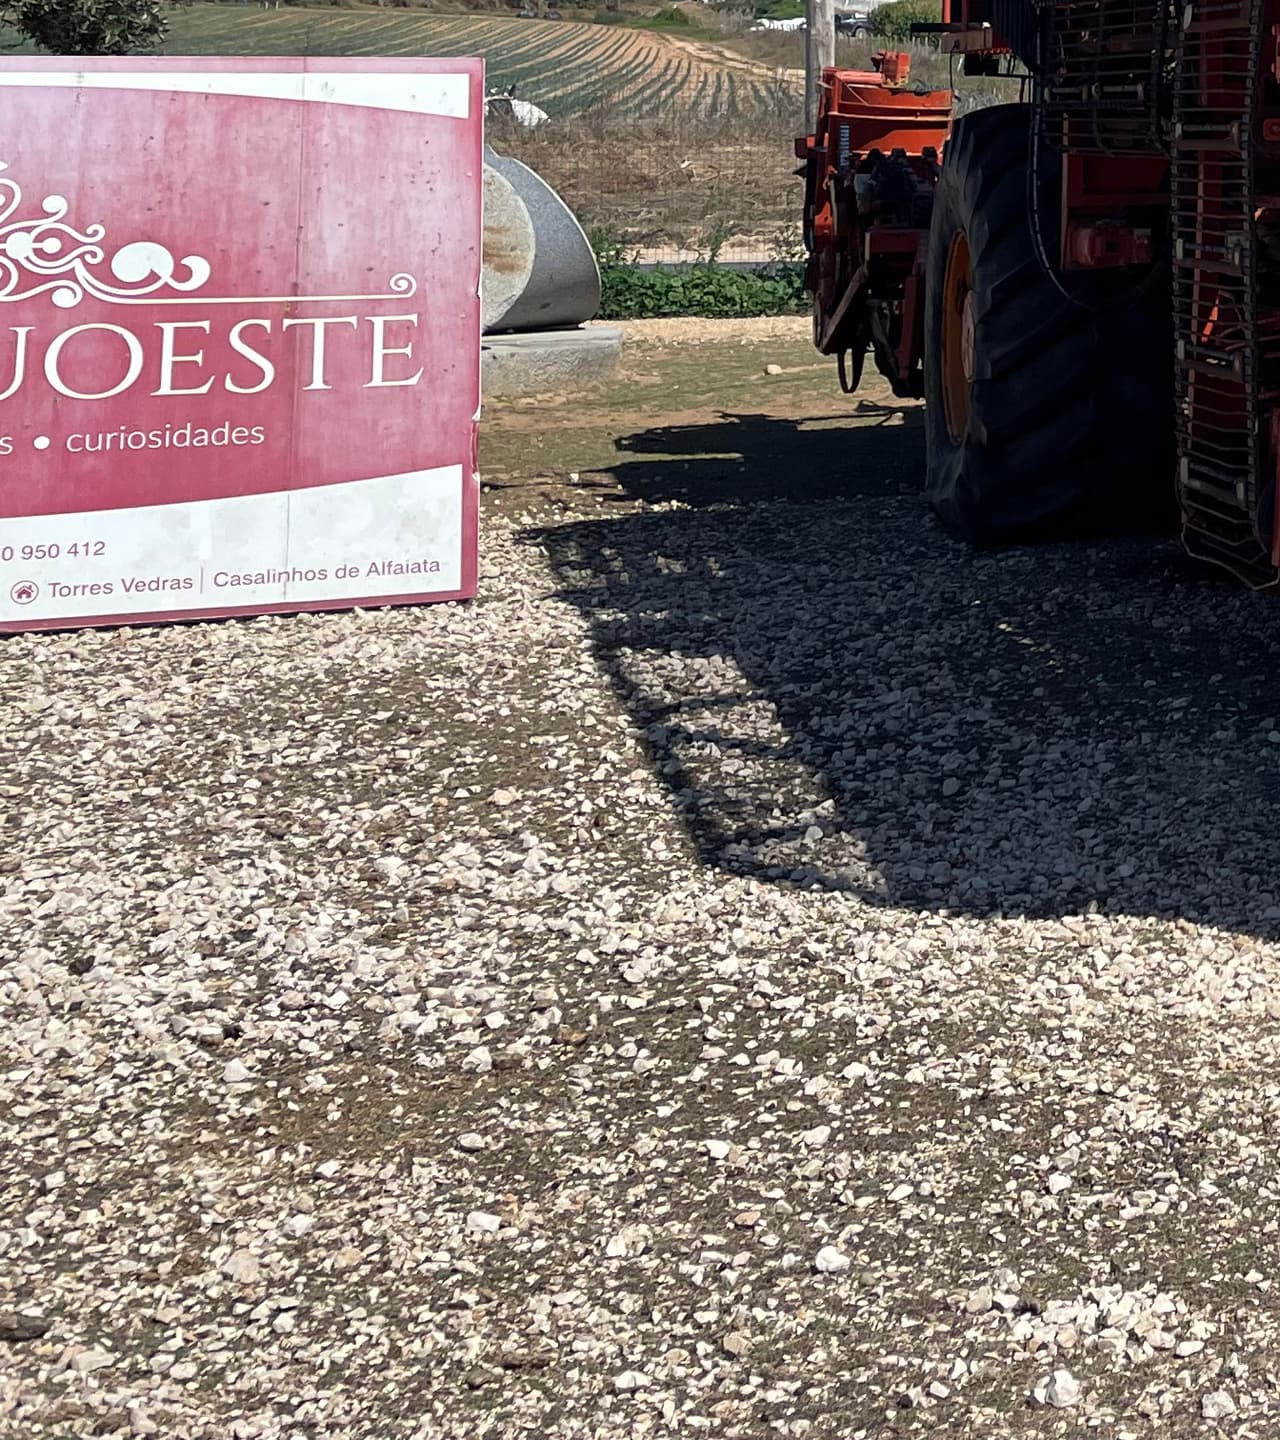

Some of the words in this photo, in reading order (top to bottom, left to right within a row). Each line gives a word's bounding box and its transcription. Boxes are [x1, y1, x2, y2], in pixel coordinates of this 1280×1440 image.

[66, 421, 265, 453] curiosidades
[21, 543, 61, 560] 950
[66, 541, 106, 557] 412
[48, 581, 114, 598] Torres
[120, 576, 194, 593] Vedras
[213, 568, 328, 587] Casalinhos
[335, 564, 360, 579] de
[366, 559, 441, 577] Alfaiata
